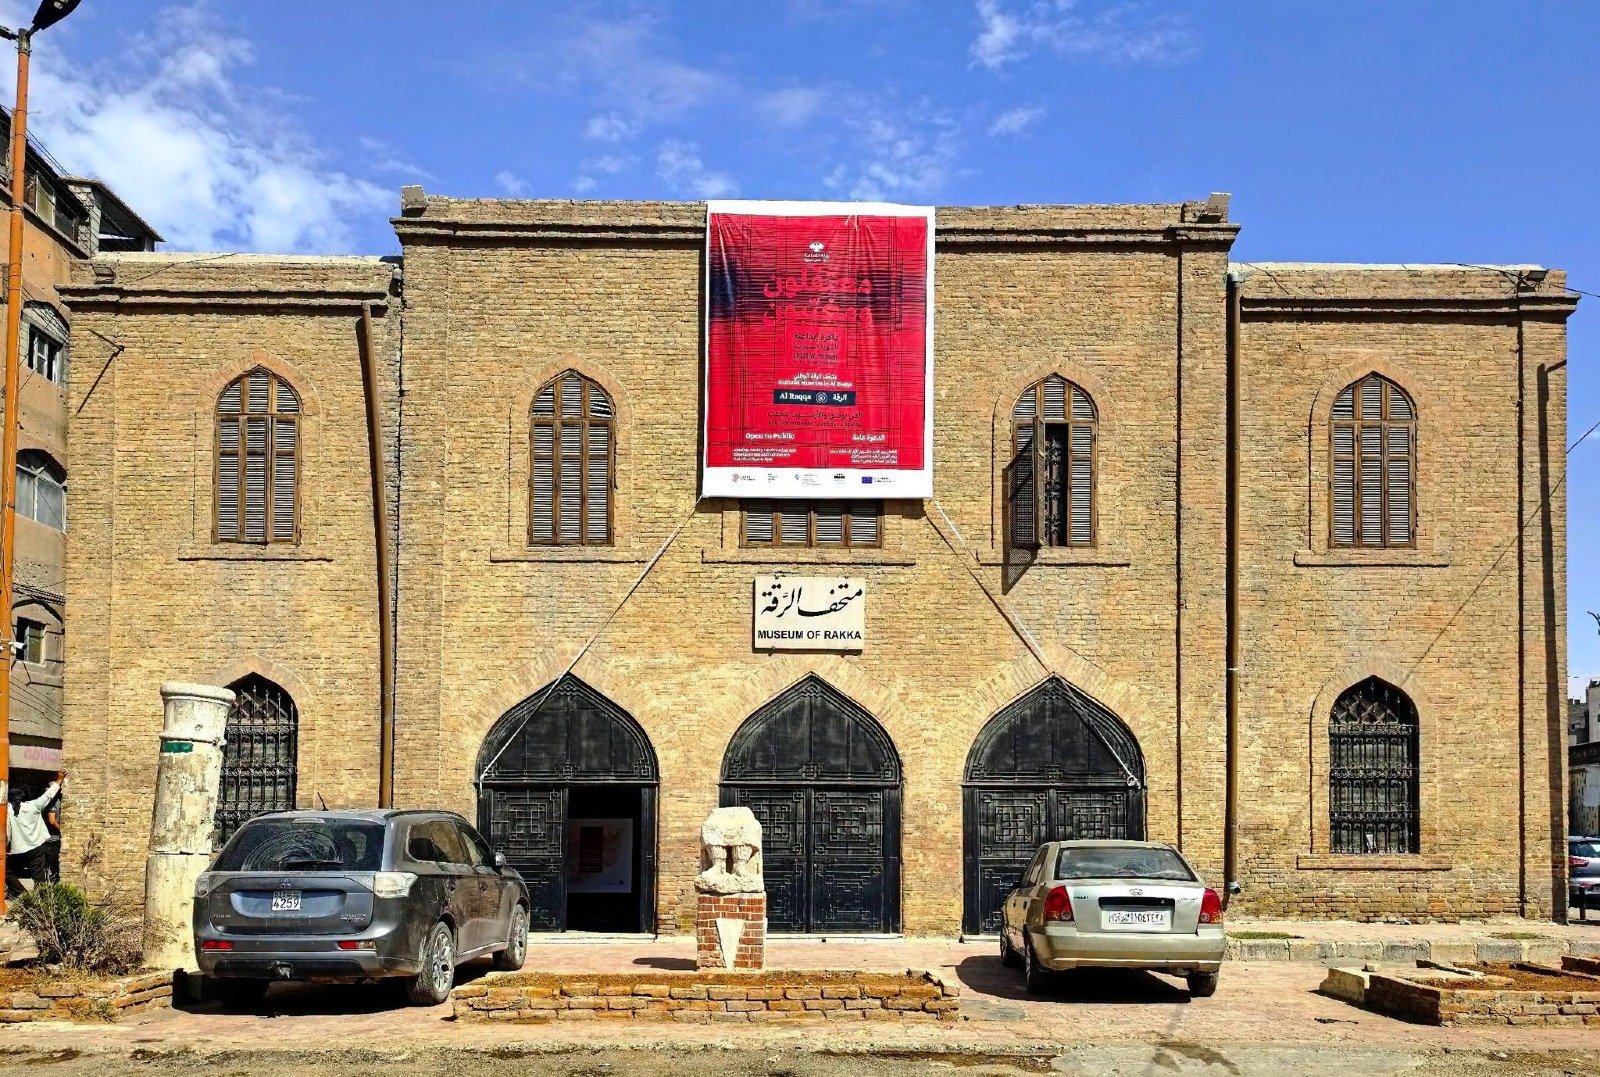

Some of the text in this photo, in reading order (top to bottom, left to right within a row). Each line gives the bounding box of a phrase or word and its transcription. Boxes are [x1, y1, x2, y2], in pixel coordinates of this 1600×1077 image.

[780, 392, 811, 401] Al Raqqa
[833, 394, 847, 402] الرقة
[798, 583, 862, 617] متحف
[758, 630, 862, 639] MUSEUM OF RAKKA
[273, 897, 300, 909] 4259
